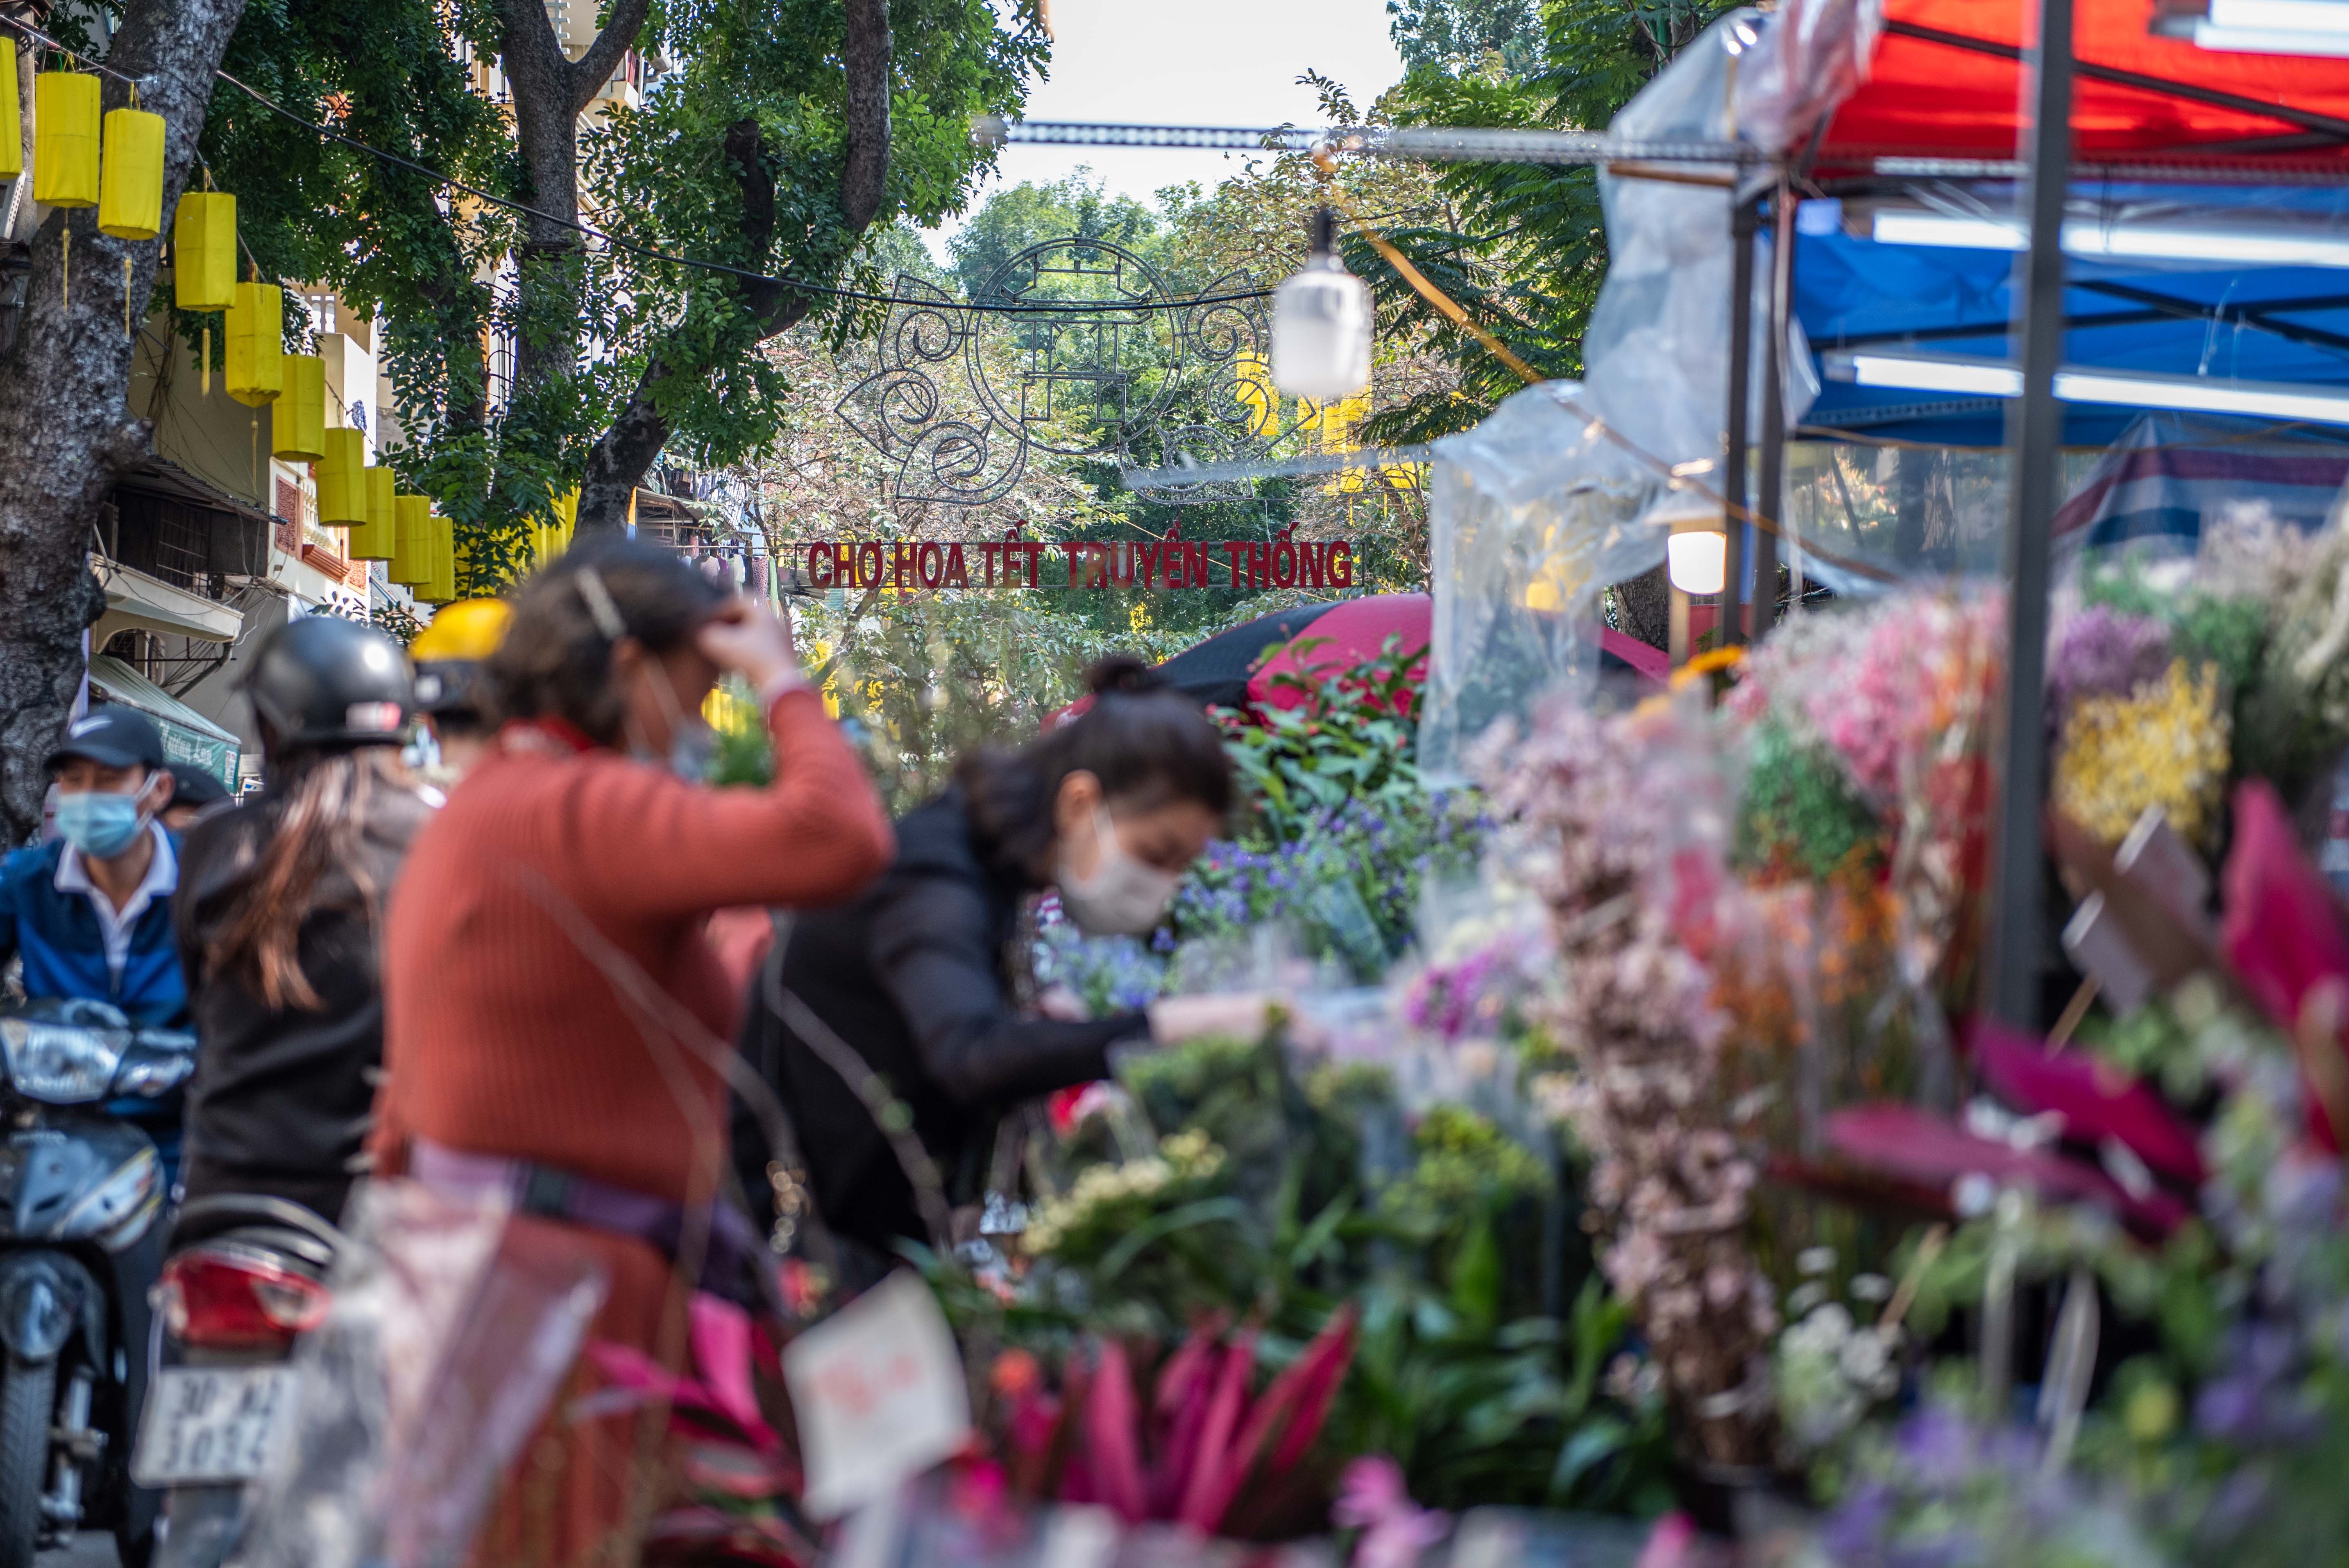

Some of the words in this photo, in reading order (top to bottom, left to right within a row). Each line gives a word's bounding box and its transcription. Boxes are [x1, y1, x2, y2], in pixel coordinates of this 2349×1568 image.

[895, 541, 970, 589] HOA
[979, 519, 1045, 589] TẾT
[1224, 521, 1352, 589] THỐNG
